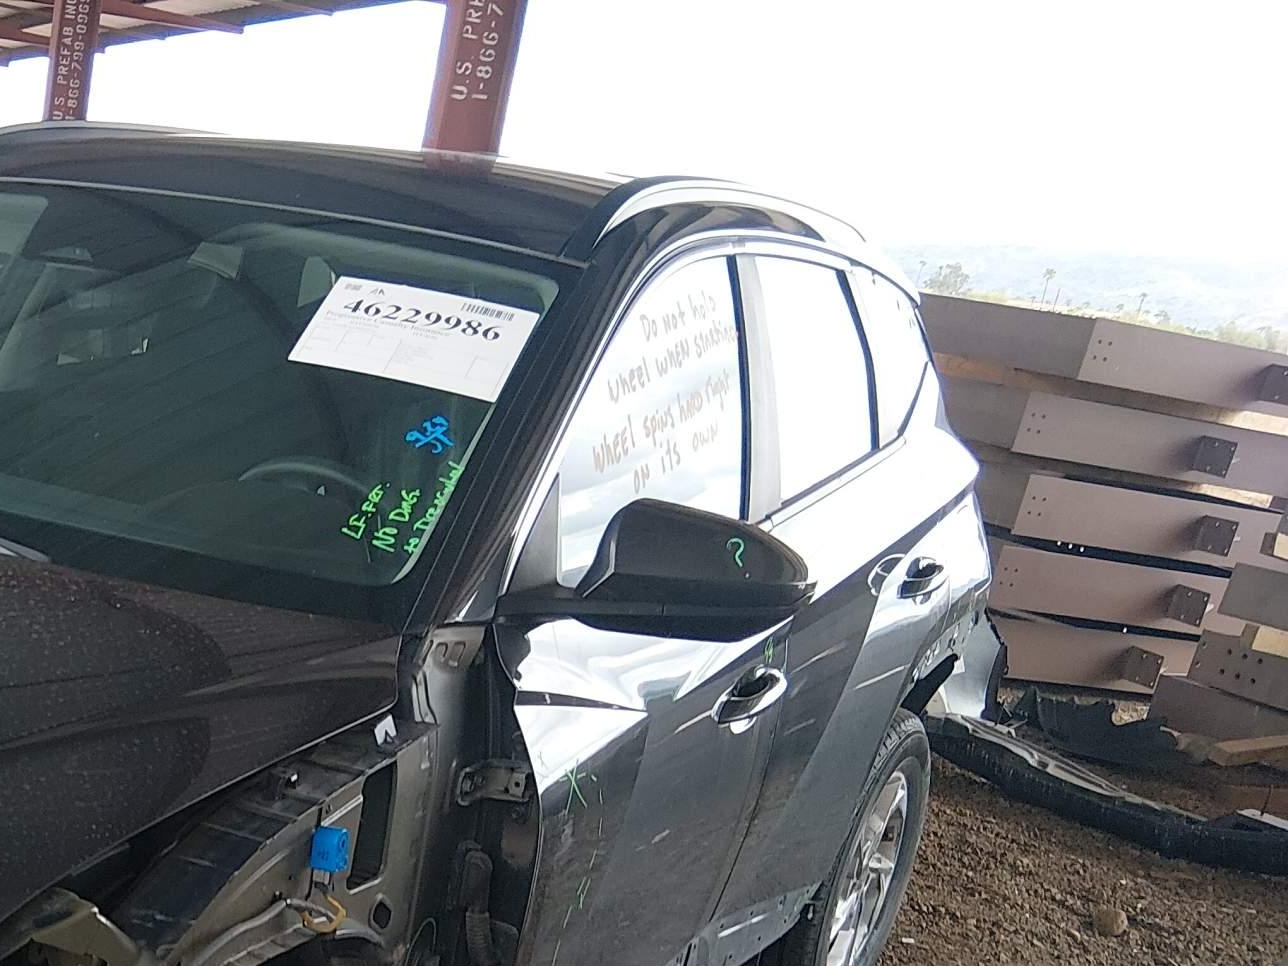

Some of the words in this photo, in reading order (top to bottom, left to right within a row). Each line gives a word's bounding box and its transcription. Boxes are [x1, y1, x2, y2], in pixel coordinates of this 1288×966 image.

[57, 26, 73, 85] PREFAB
[65, 0, 90, 120] 1-866-799-096
[472, 2, 504, 99] 1-866-7
[343, 298, 504, 342] 46229986
